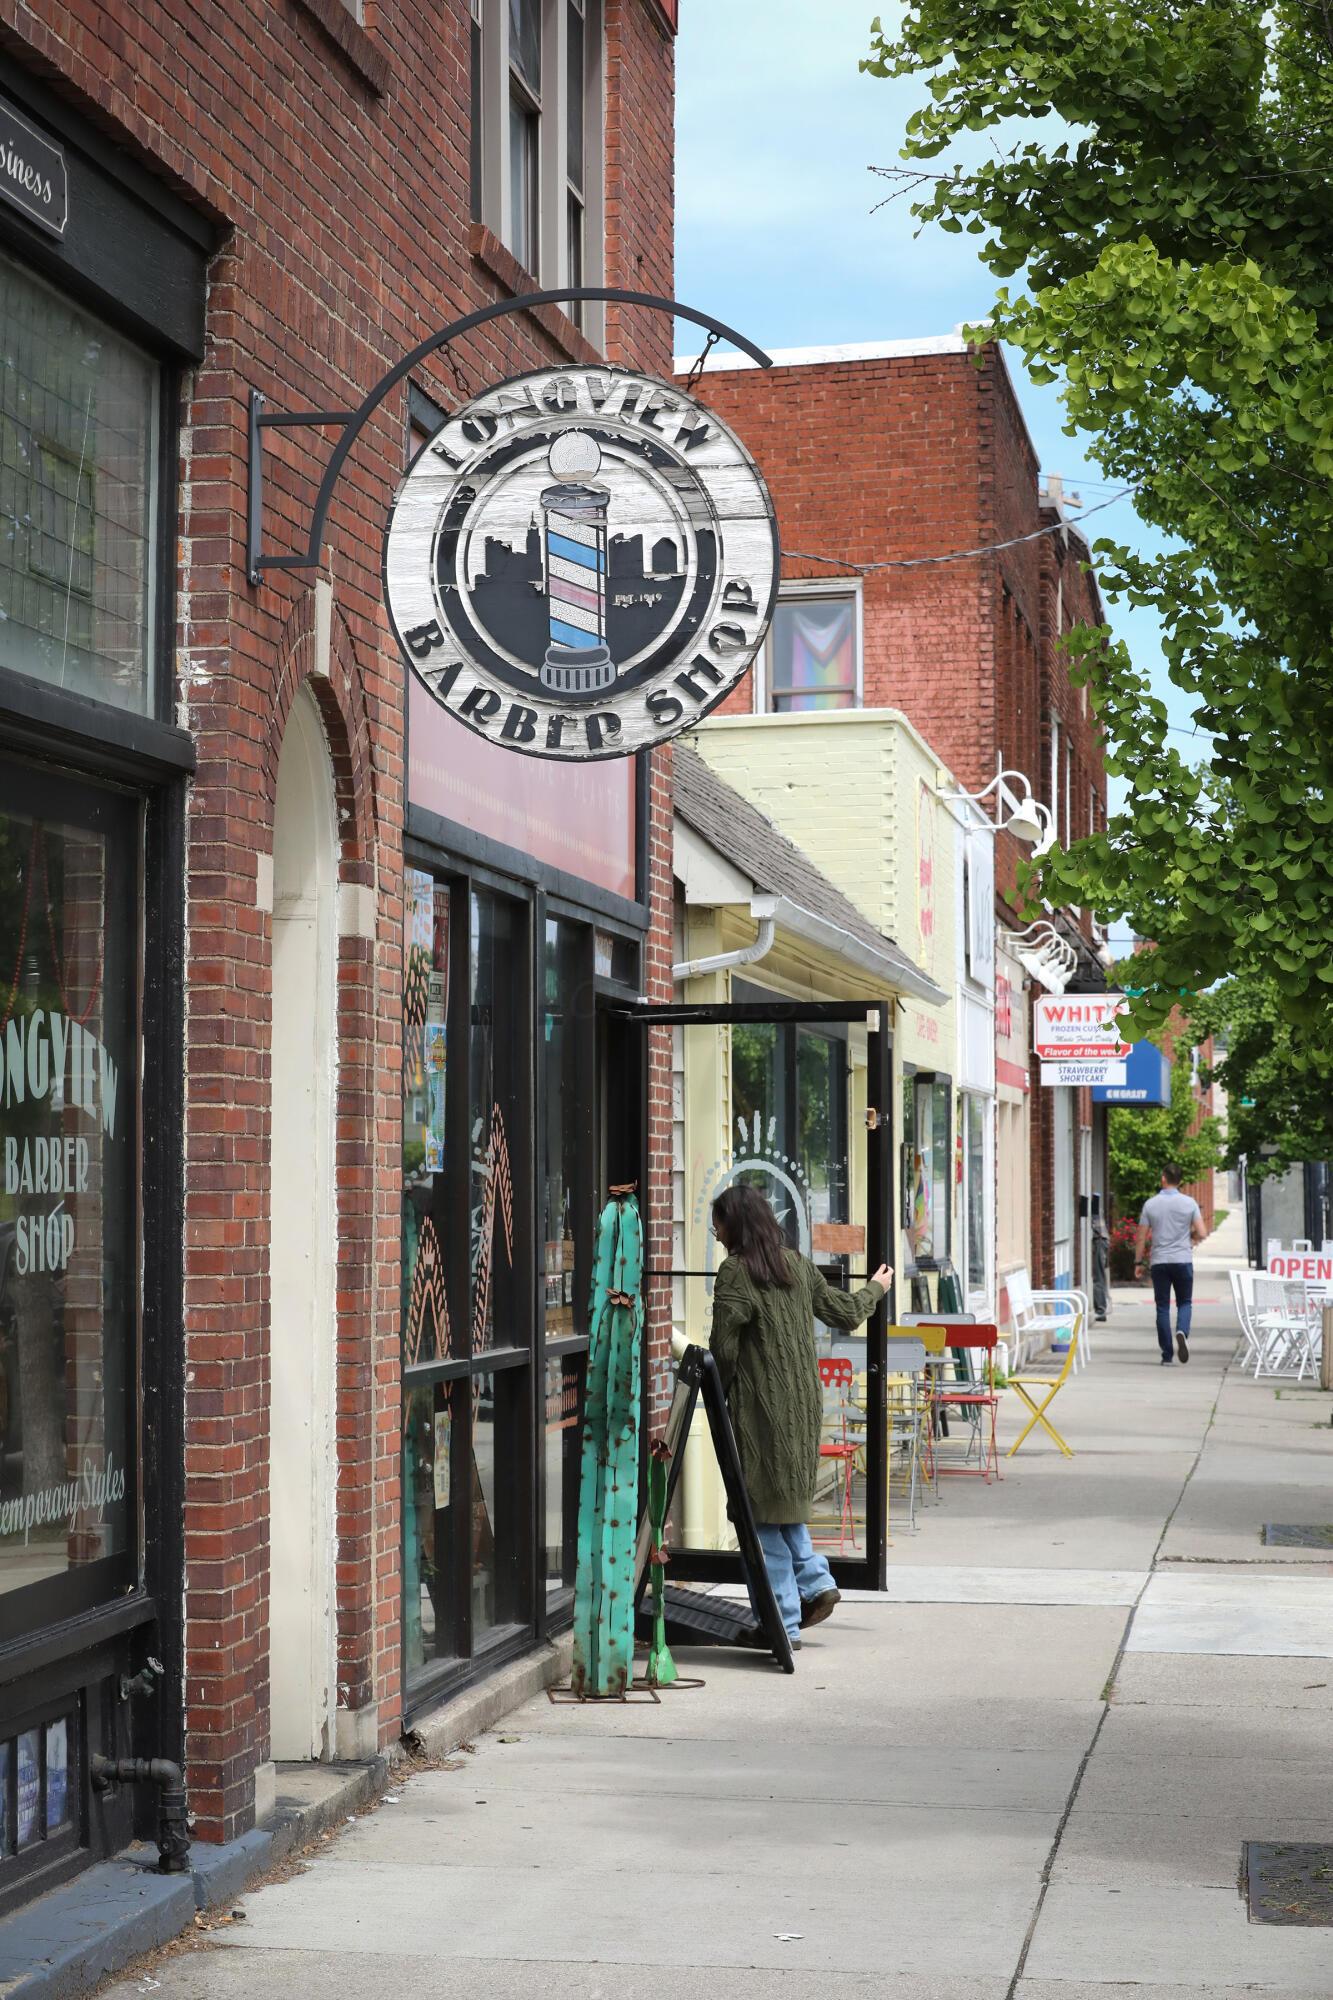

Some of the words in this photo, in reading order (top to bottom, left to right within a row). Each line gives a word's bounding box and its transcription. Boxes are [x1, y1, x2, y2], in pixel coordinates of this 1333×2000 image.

[431, 375, 721, 472] LONGVIEW
[403, 619, 625, 753] BARBER
[645, 577, 759, 726] SHOP
[0, 1008, 118, 1141] NGVIEW
[1044, 1047, 1072, 1056] Flavor
[1073, 1047, 1083, 1056] of
[1084, 1047, 1099, 1056] the
[1058, 1066, 1108, 1074] STRAWBERRY
[5, 1136, 89, 1195] BARBER
[16, 1213, 75, 1276] SHOP
[1270, 1257, 1332, 1279] OPEN
[0, 1481, 80, 1547] emporary
[82, 1451, 125, 1522] Styles
